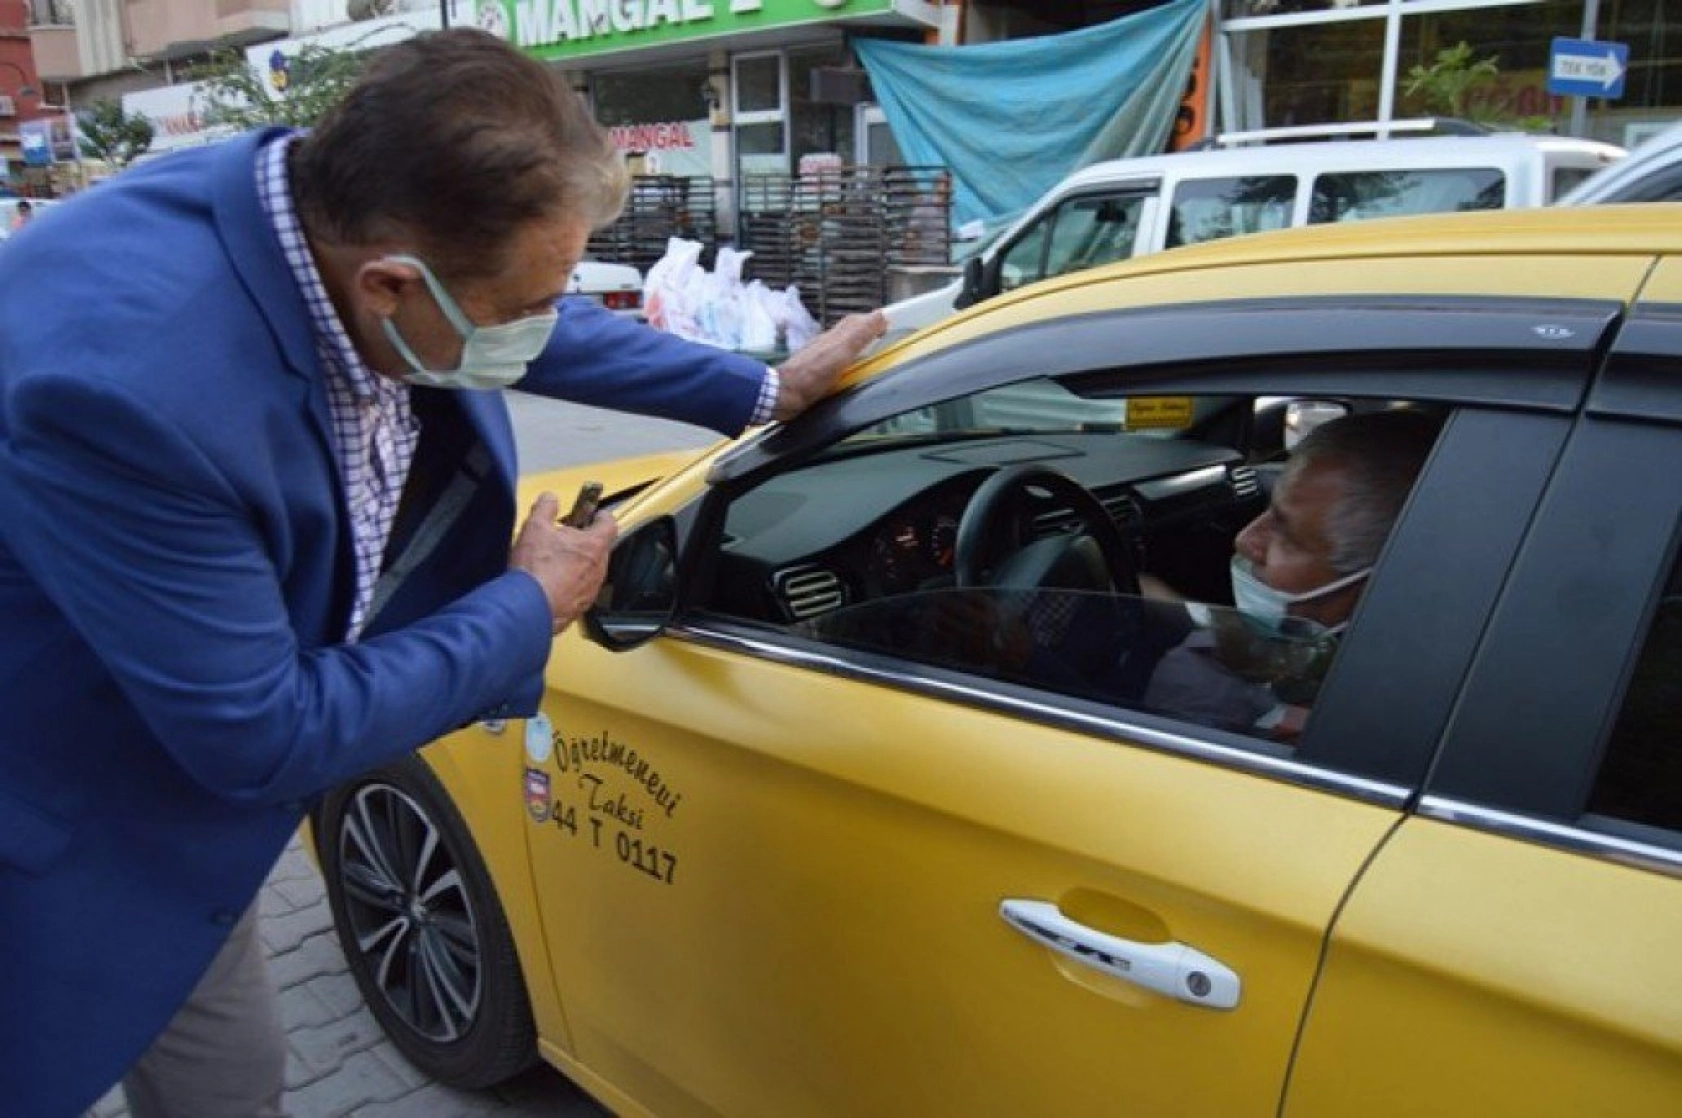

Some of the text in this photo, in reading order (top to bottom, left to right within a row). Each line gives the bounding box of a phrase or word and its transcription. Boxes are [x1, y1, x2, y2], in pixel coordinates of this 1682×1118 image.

[611, 123, 695, 151] MANGAL
[578, 773, 644, 830] Taksi
[552, 800, 677, 886] 44 T 0117
